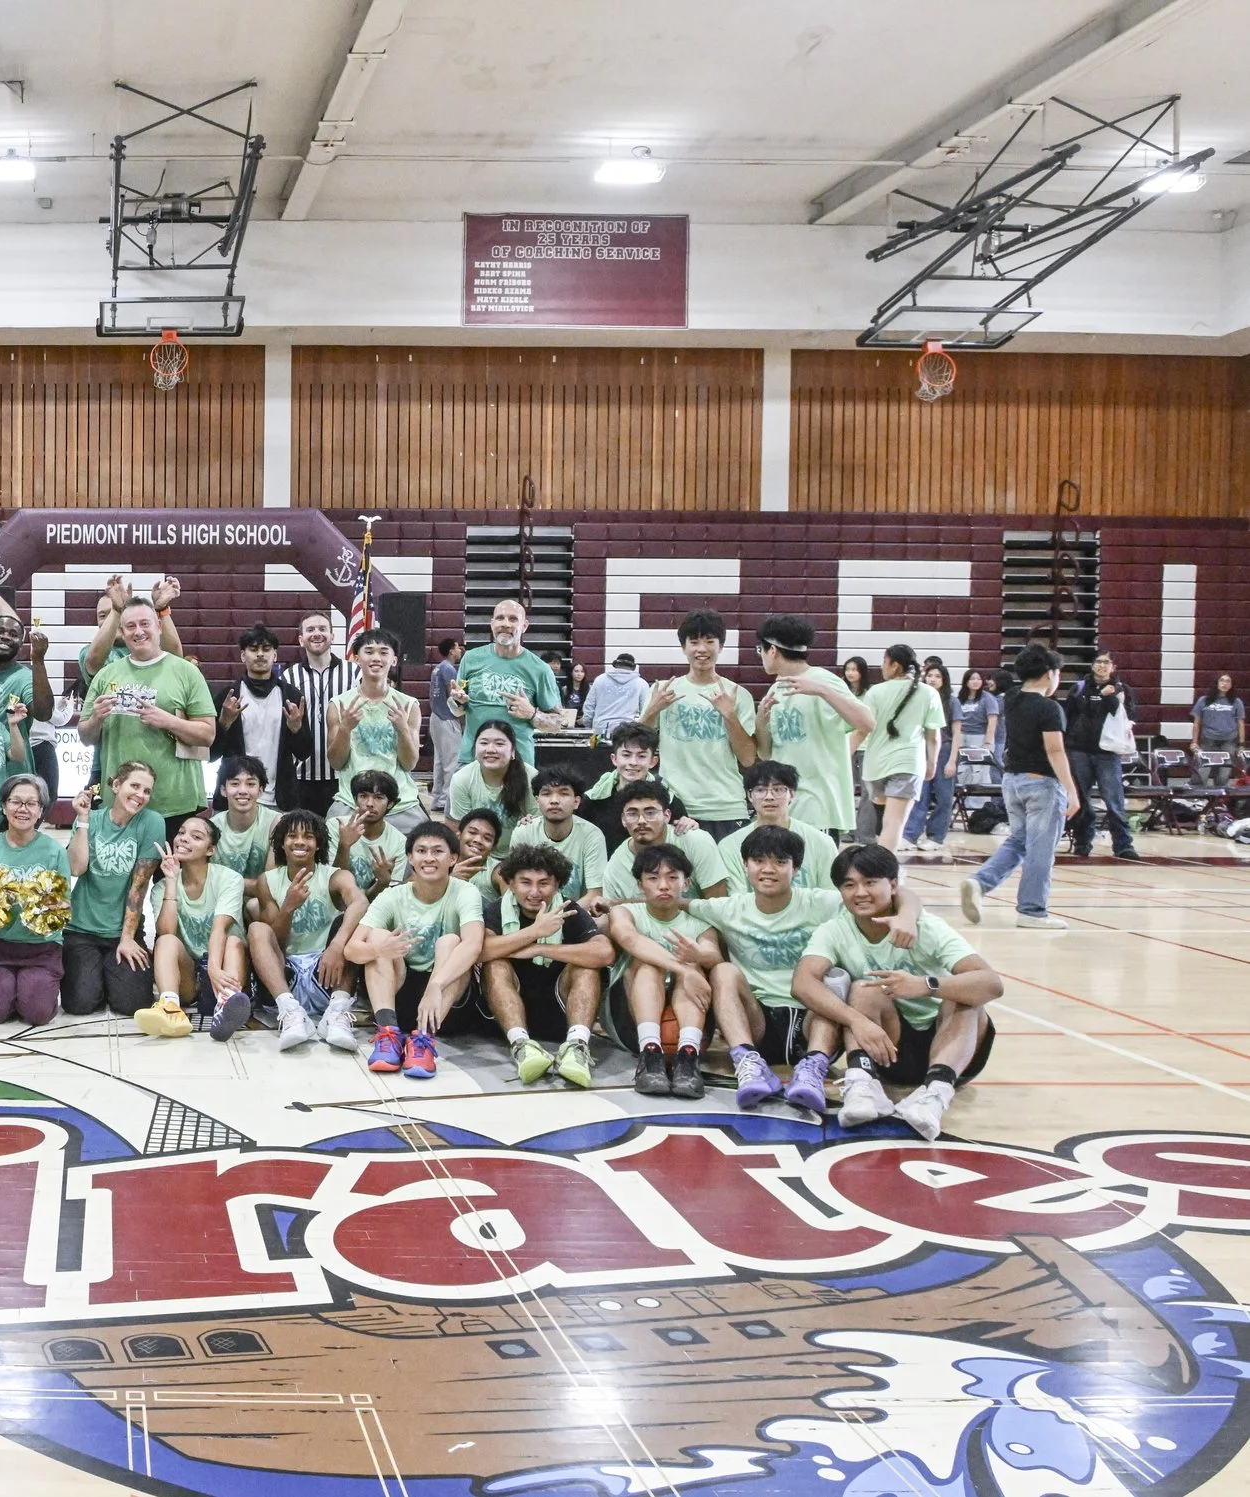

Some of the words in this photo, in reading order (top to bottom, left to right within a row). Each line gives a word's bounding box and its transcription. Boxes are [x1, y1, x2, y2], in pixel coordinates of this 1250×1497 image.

[502, 220, 520, 232] IN
[525, 220, 626, 232] RECOGNITION
[632, 222, 650, 233] OF
[538, 234, 556, 245] 25
[561, 234, 610, 246] YEARS
[492, 247, 510, 258] OF
[515, 247, 591, 259] COACHING
[596, 248, 660, 260] SERVICE
[46, 524, 128, 544] PIEDMONT
[132, 524, 177, 545] HILLS
[181, 524, 220, 545] HIGH
[224, 524, 292, 545] SCHOOL
[55, 732, 80, 744] DON
[76, 764, 92, 776] 19
[95, 836, 139, 863] BASKET
[98, 855, 133, 874] BRAW
